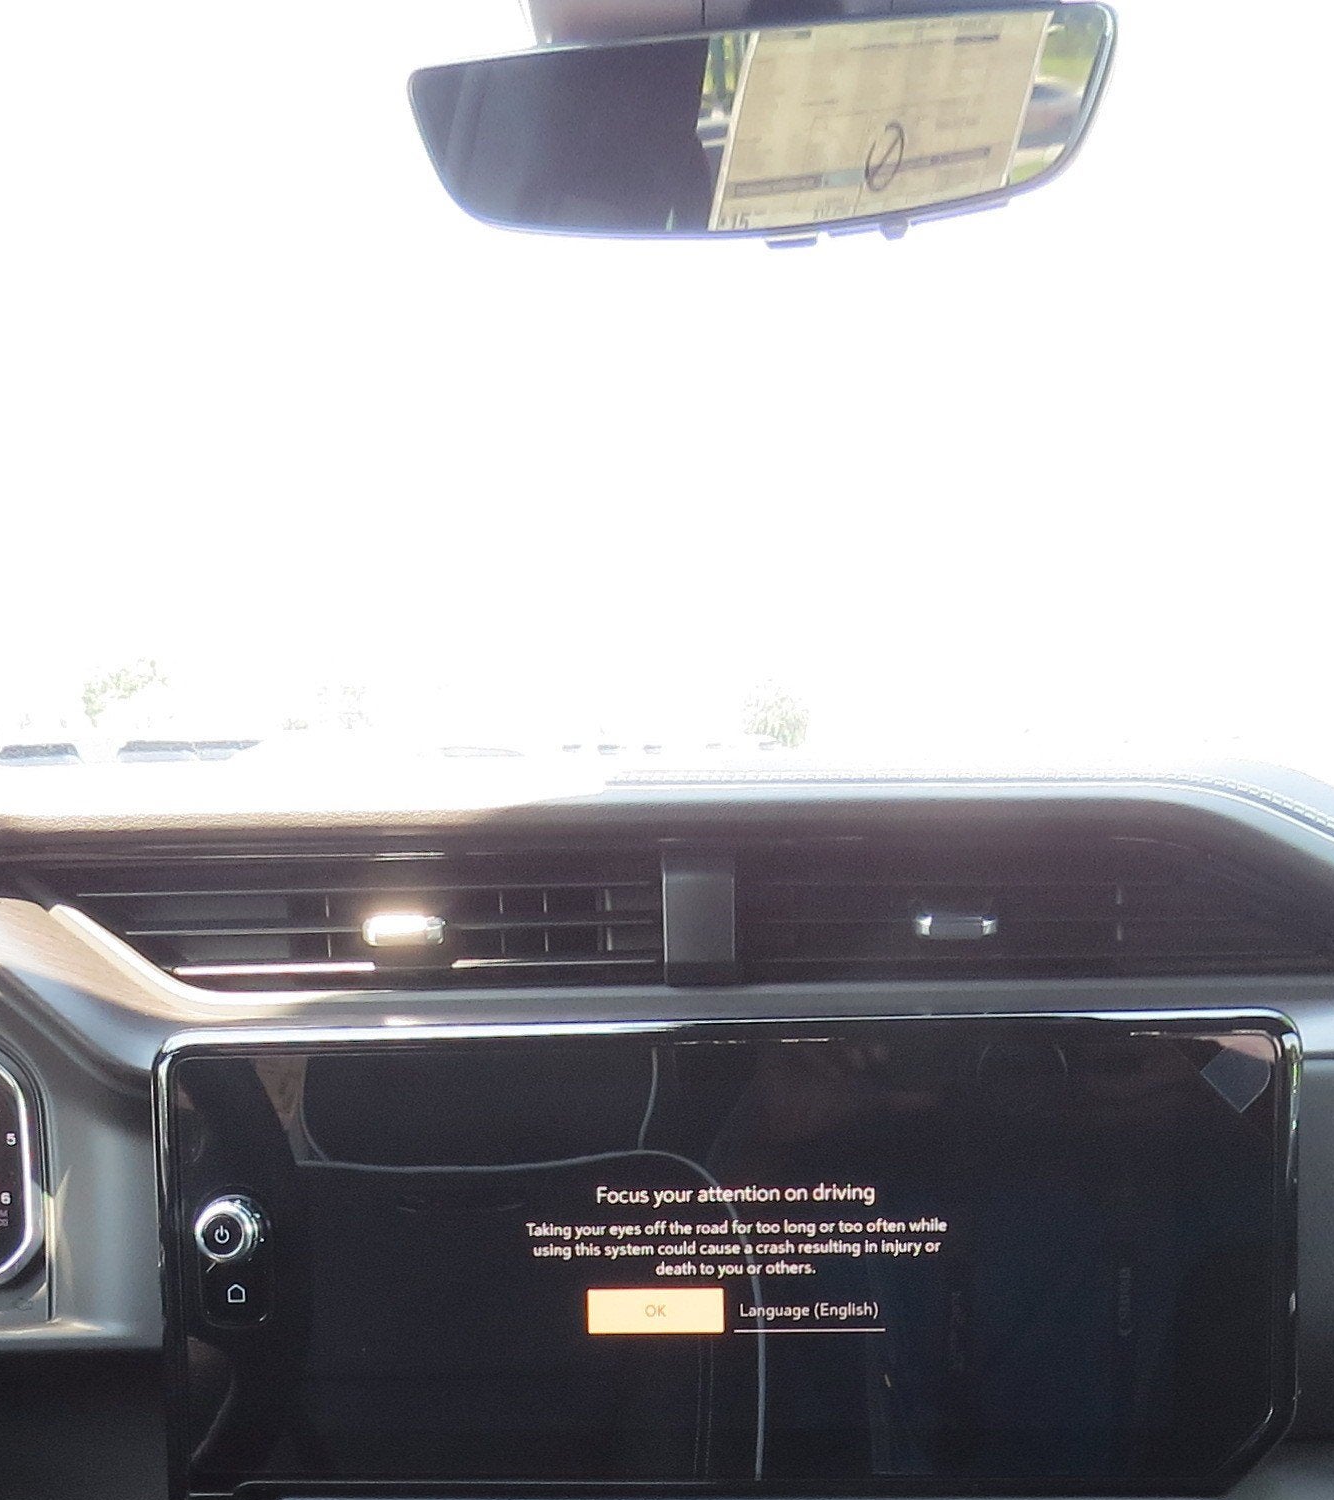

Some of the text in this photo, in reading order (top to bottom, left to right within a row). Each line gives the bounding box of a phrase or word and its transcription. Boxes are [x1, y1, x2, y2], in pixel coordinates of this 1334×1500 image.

[7, 1133, 17, 1146] 5
[1, 1192, 11, 1204] 6
[596, 1183, 875, 1208] Focus your attention on driving
[525, 1218, 947, 1240] Taking your eyes off the road for too long or too often while
[533, 1239, 941, 1260] using this system could cause a crash resulting in injury or
[655, 1260, 816, 1279] death to you or others.
[645, 1304, 667, 1318] OK
[739, 1302, 879, 1321] Language (English)
